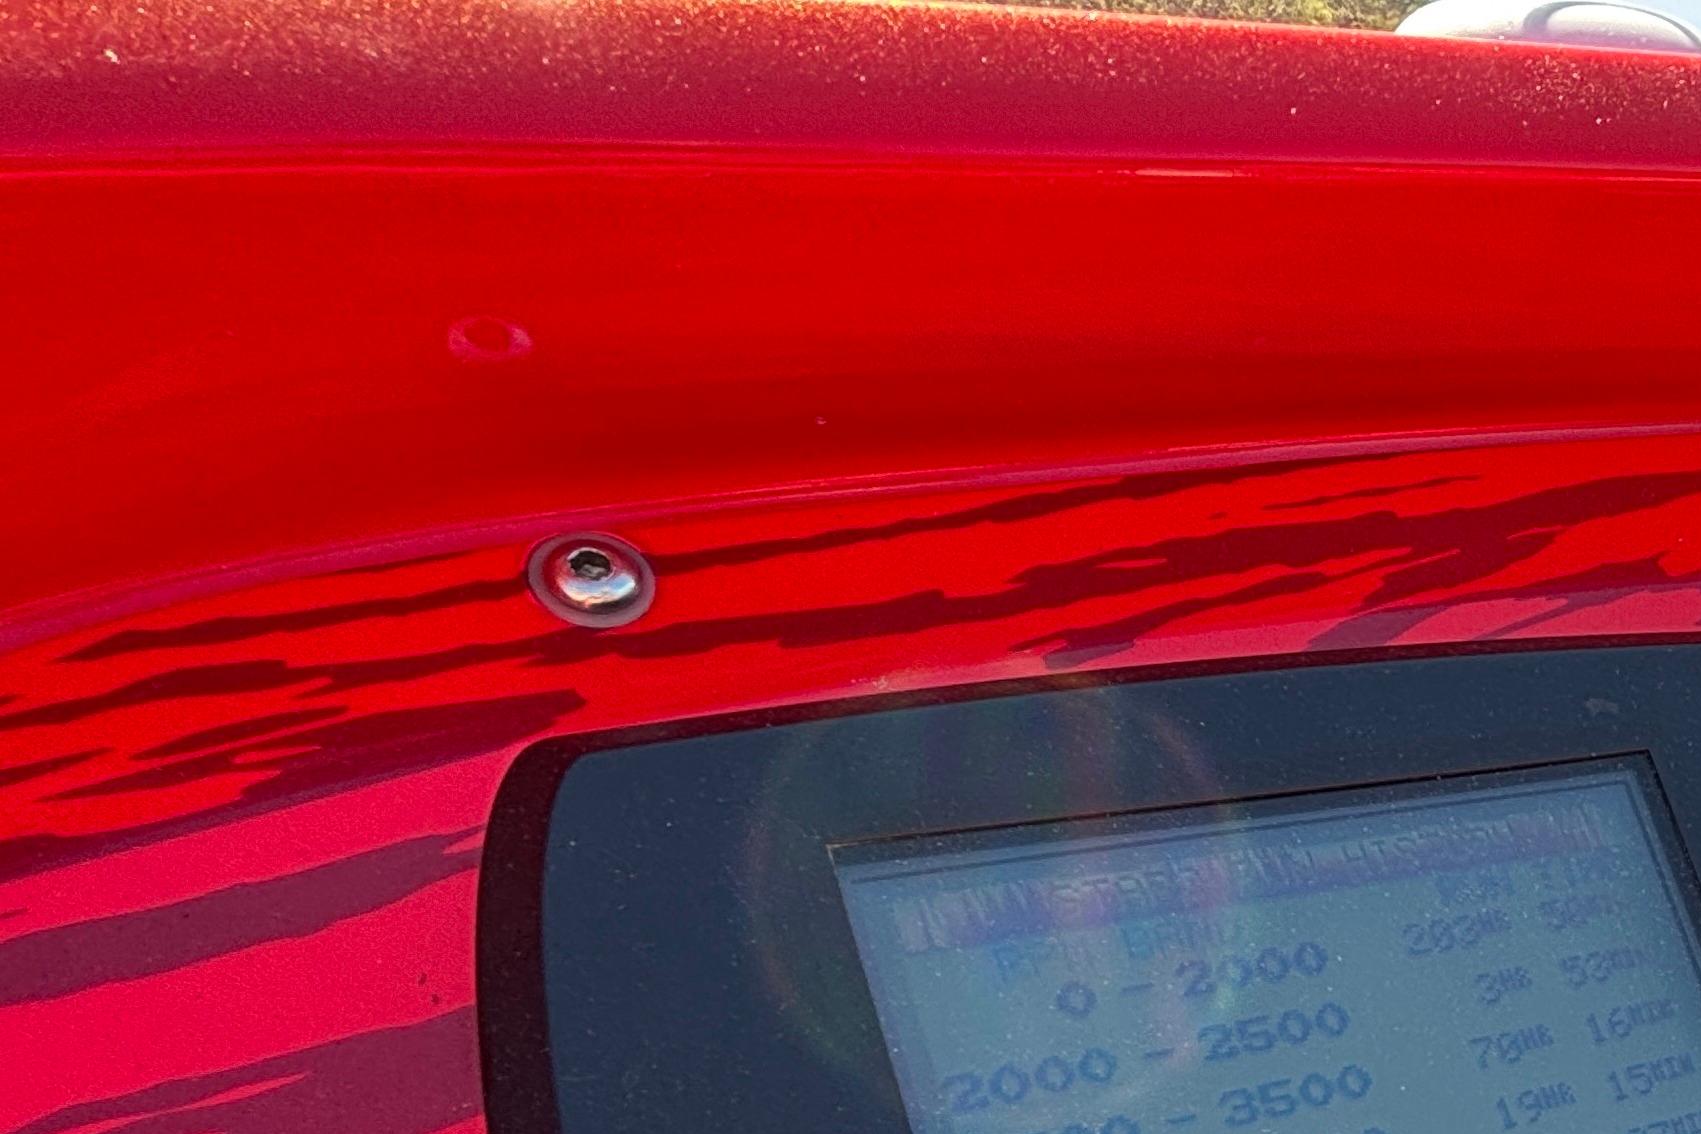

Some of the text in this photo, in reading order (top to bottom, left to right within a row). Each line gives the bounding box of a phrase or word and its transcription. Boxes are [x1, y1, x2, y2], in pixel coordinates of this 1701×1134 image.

[1055, 980, 1098, 1018] 0
[1174, 941, 1329, 998] 2000
[942, 1047, 1118, 1113] 2000
[1197, 1002, 1351, 1062] 2500
[1218, 1063, 1372, 1127] 3500
[1495, 1082, 1577, 1130] 19HR
[1607, 1052, 1696, 1102] 15MIN
